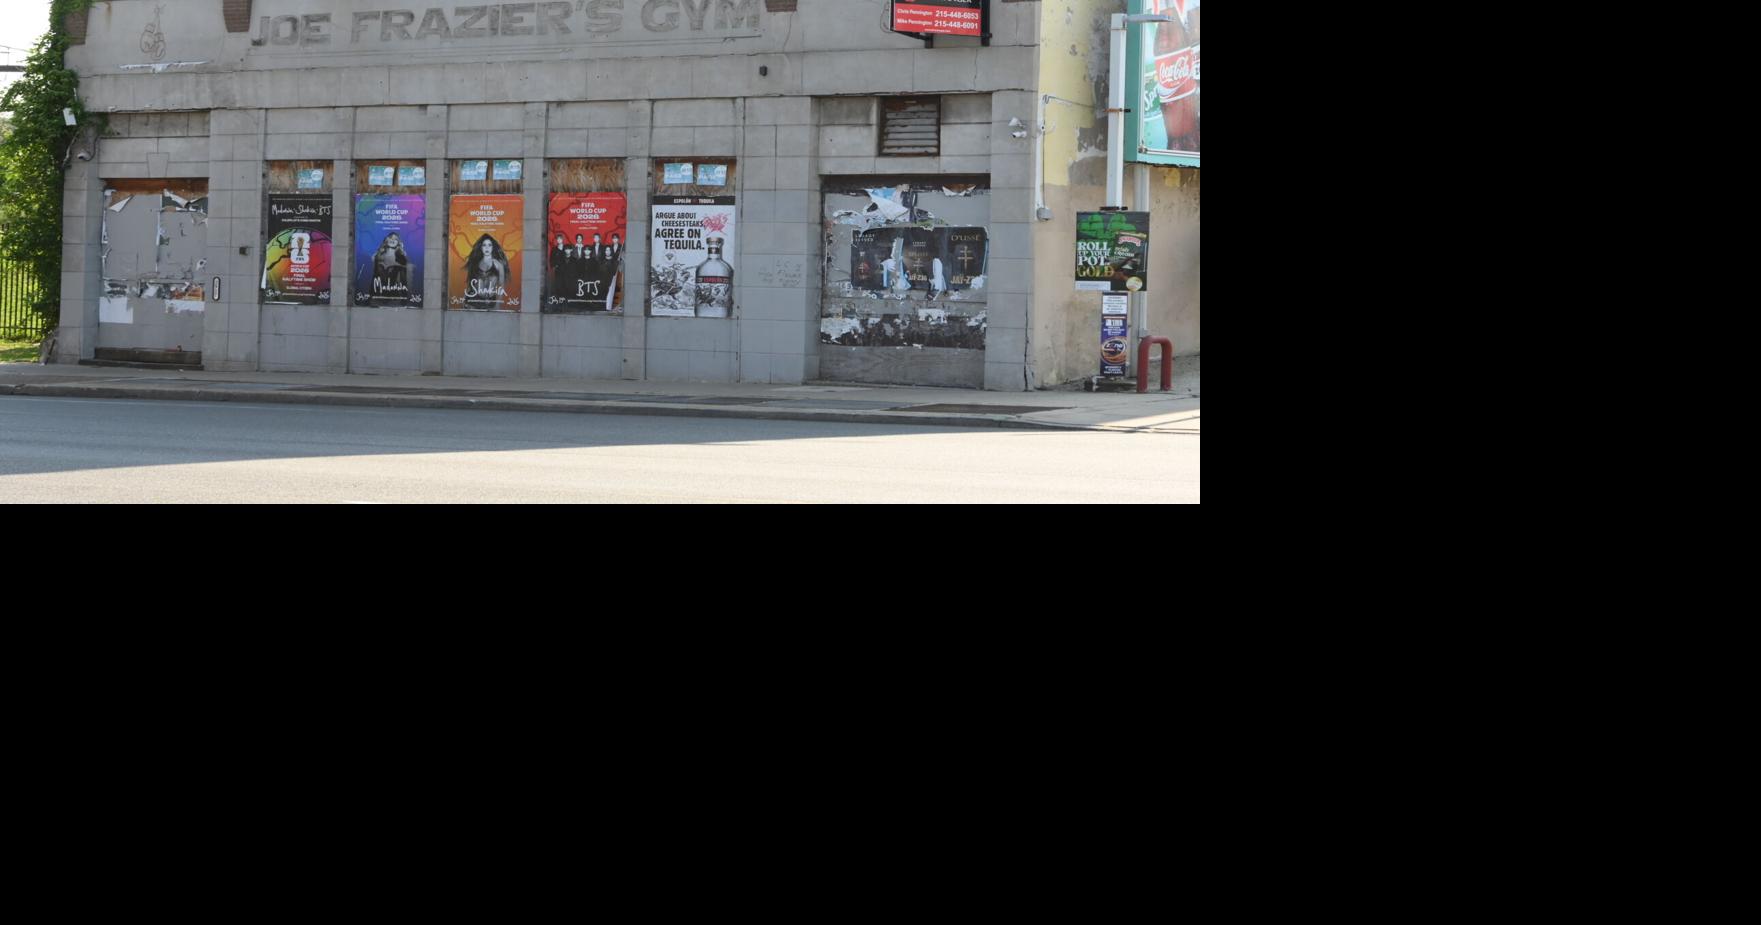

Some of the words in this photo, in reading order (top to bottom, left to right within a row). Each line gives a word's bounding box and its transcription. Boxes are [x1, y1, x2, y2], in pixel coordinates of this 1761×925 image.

[935, 10, 979, 20] 215-448-6053
[250, 13, 332, 47] JOE
[352, 0, 625, 44] FRAZIER'S
[640, 0, 761, 33] GYM
[934, 20, 978, 30] 215-448-6091
[655, 229, 685, 239] AGREE
[687, 229, 701, 239] ON
[664, 239, 705, 250] TEQUILA.
[1077, 241, 1109, 251] ROLL
[1090, 249, 1110, 257] YOUR
[1077, 265, 1115, 277] GOLD
[373, 276, 408, 294] Madonna
[464, 279, 508, 298] Shakira
[576, 279, 601, 297] BTS
